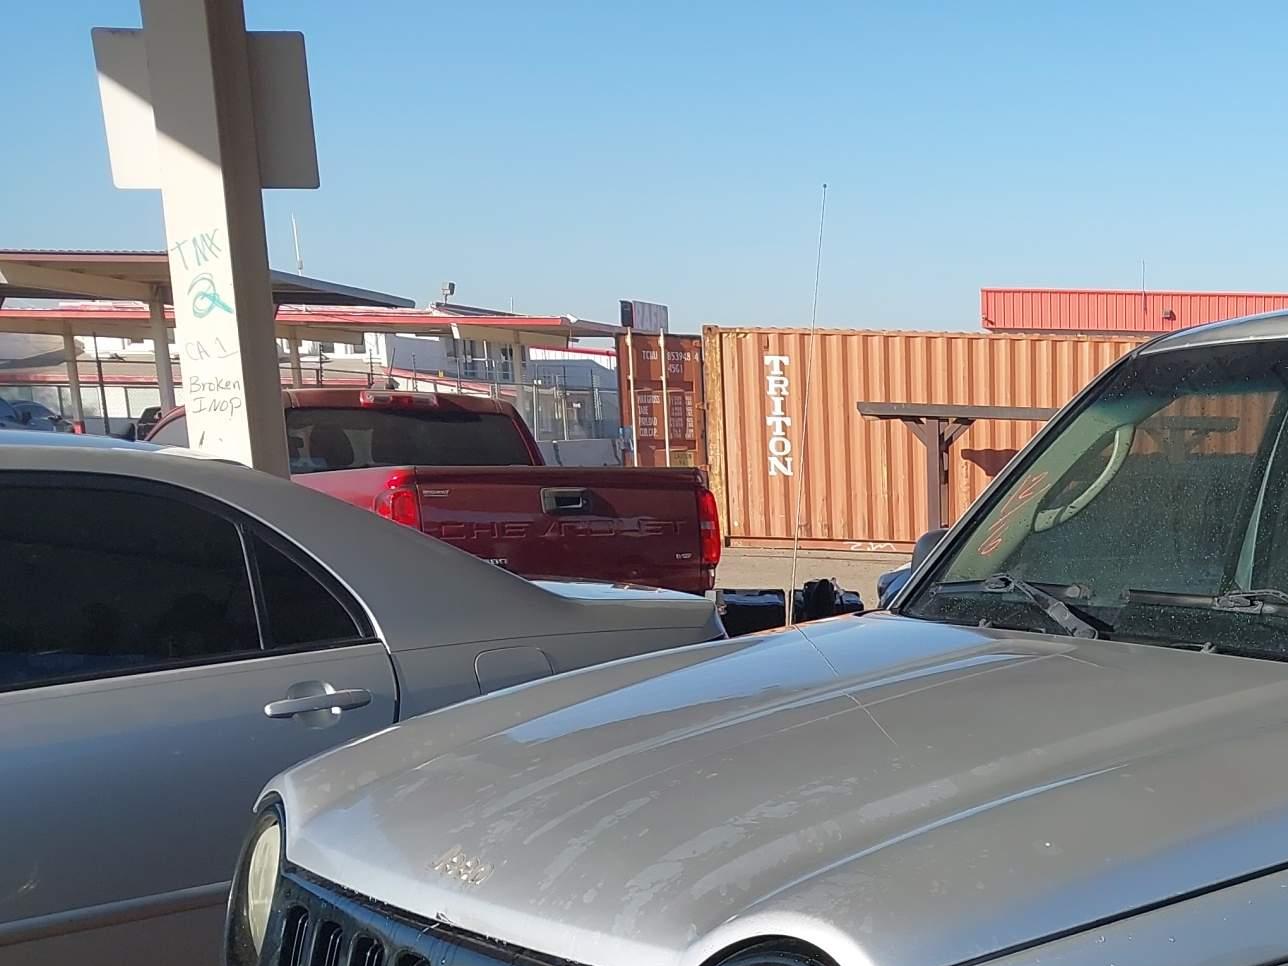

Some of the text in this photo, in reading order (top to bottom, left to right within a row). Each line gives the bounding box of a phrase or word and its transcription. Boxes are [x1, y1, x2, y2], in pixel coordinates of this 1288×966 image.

[190, 376, 241, 393] Broken
[192, 397, 242, 416] INOP
[763, 355, 793, 476] TRITON
[439, 520, 687, 540] CHEVROLET
